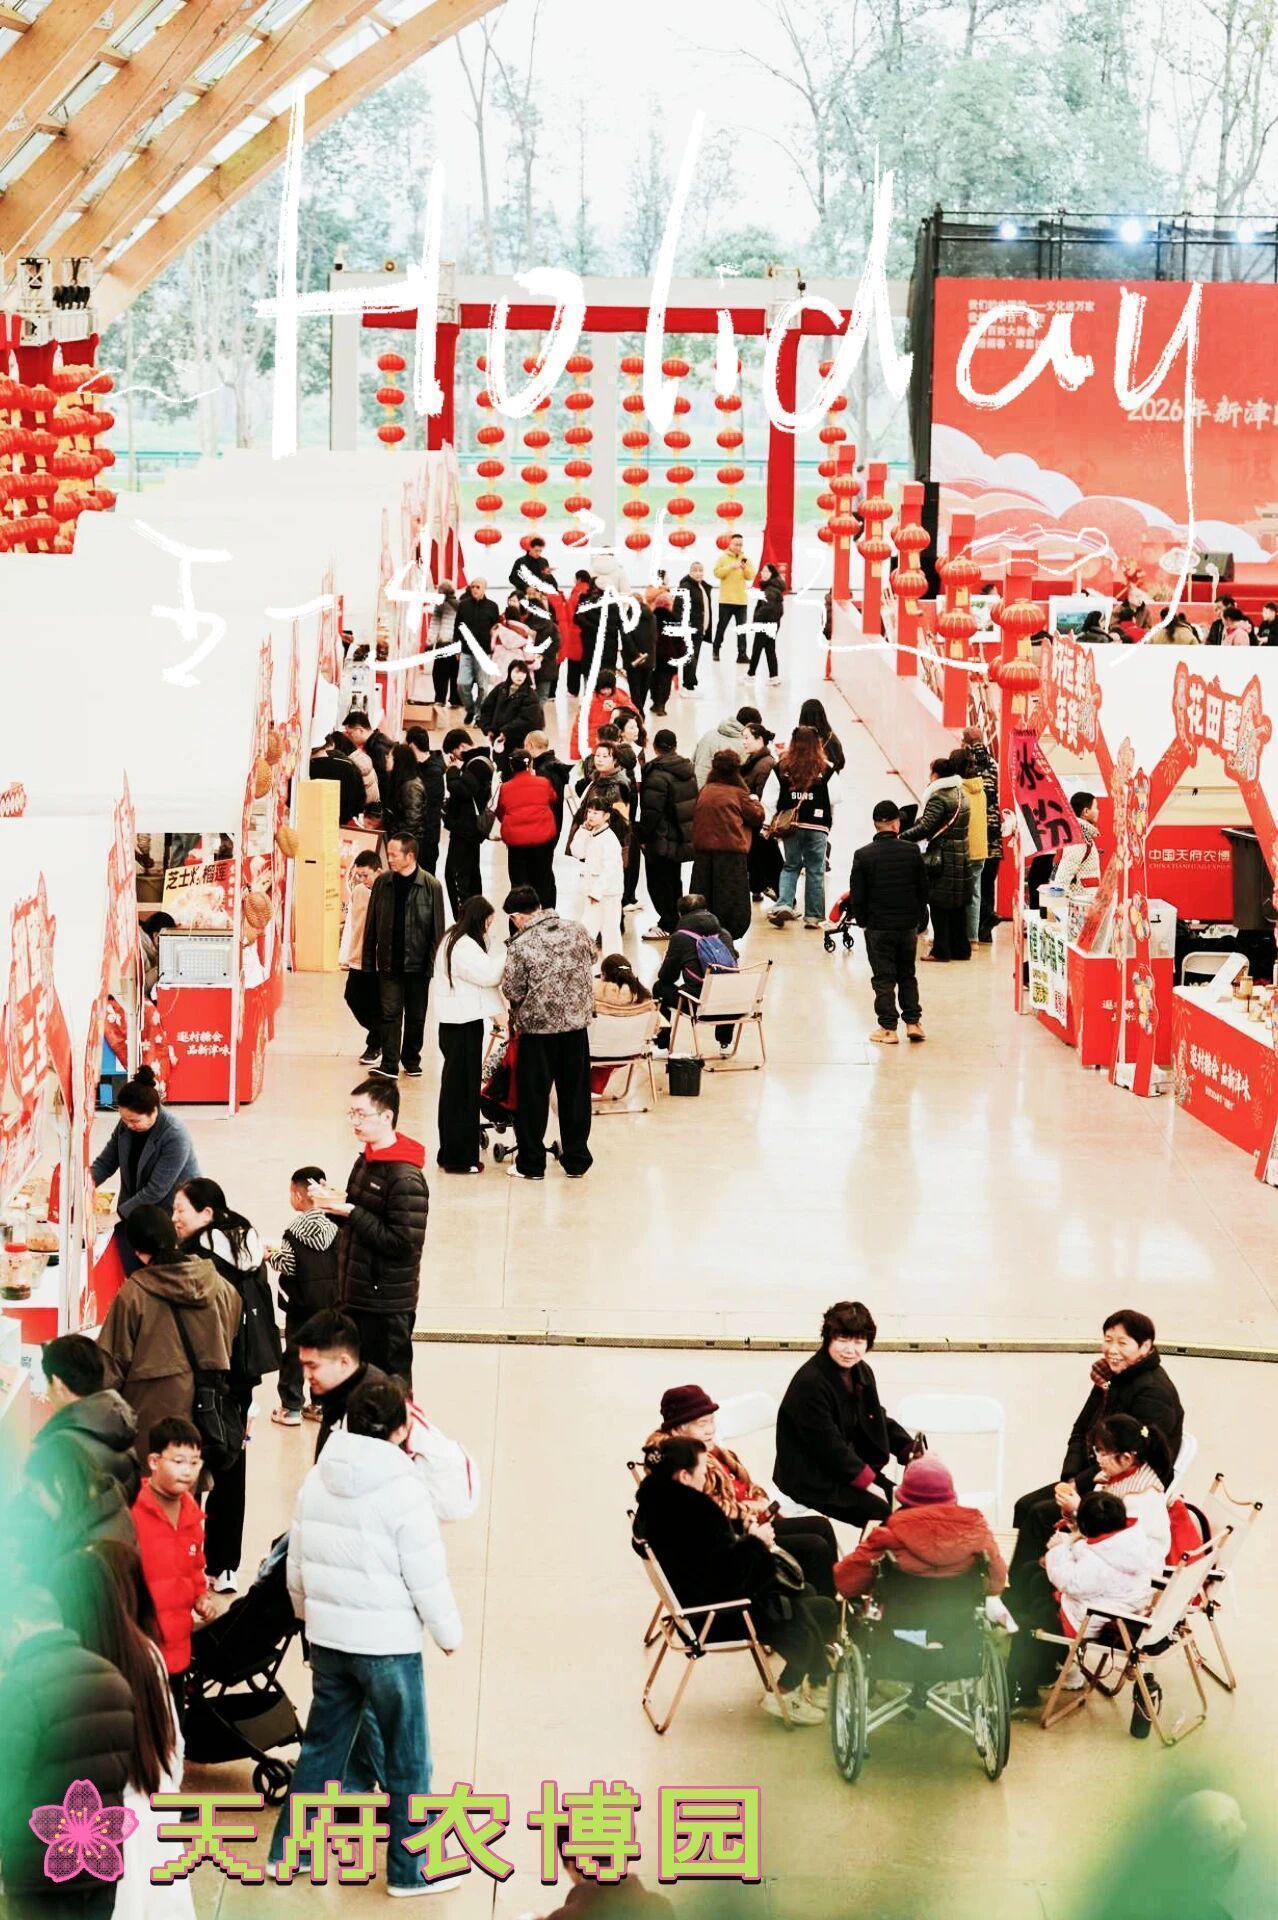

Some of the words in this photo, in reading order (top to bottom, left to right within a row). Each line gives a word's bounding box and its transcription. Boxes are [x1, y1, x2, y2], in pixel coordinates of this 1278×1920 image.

[1127, 394, 1278, 431] 2026年新津
[1187, 681, 1242, 755] 花田蜜
